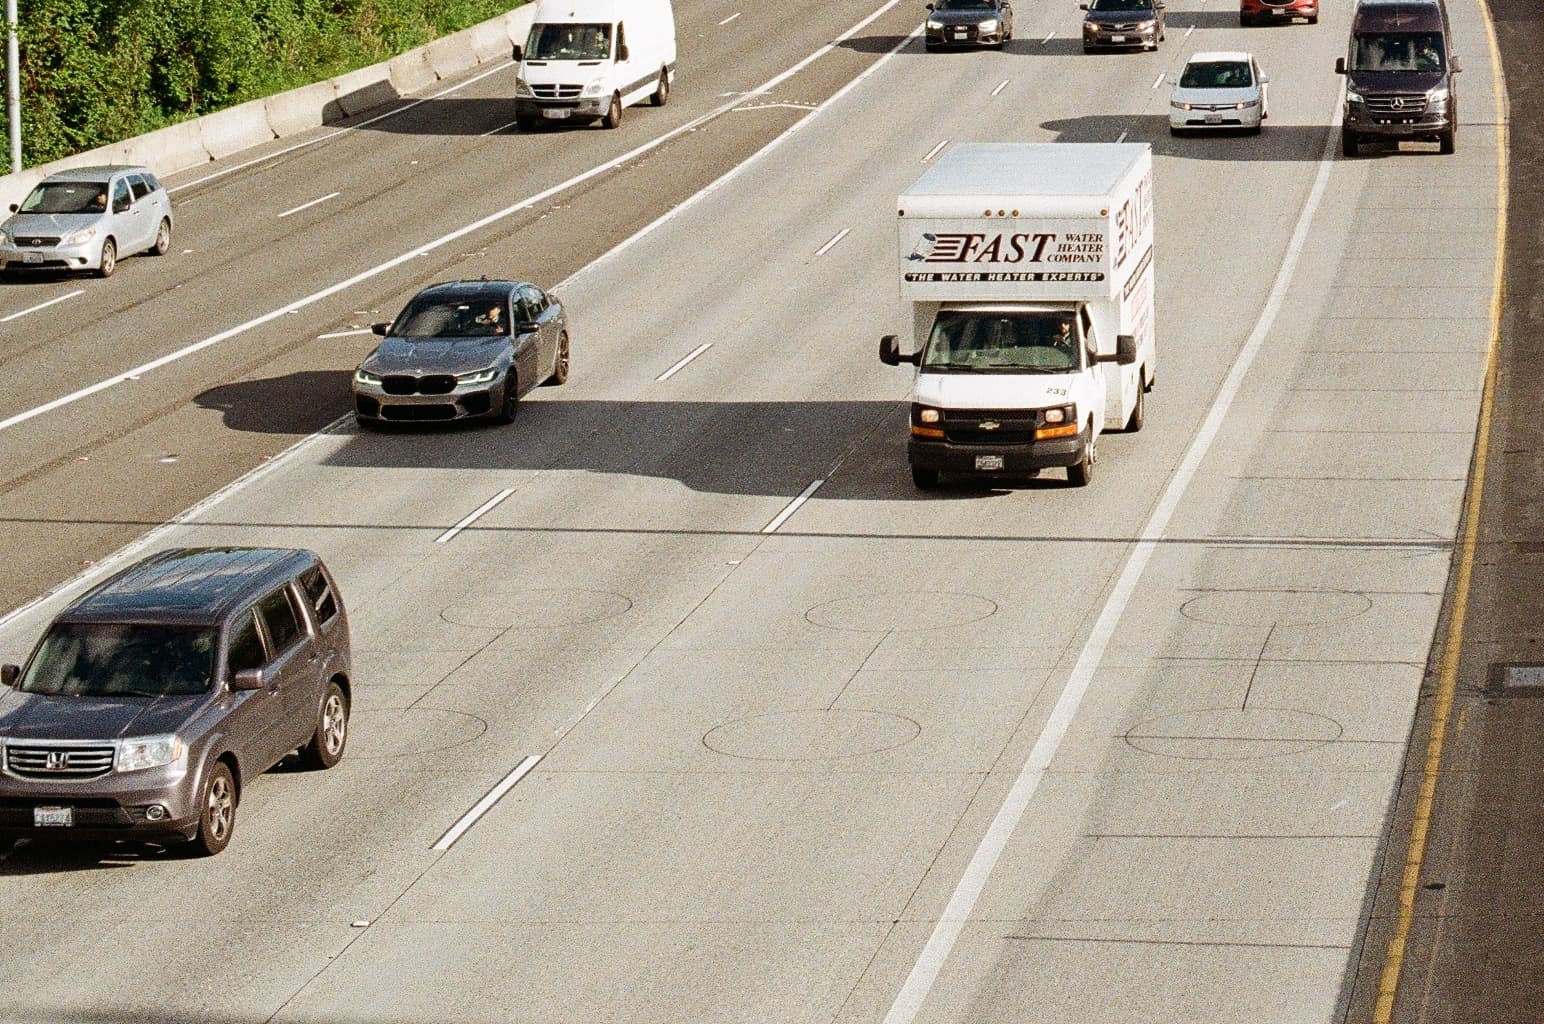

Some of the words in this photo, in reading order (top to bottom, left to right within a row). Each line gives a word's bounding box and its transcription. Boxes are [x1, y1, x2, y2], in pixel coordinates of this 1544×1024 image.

[1065, 233, 1103, 243] WATER
[957, 233, 1056, 263] FAST
[1057, 243, 1103, 253] HEATER
[1047, 254, 1102, 263] COMPANY
[941, 273, 980, 282] WATER
[988, 273, 1034, 282] HEATER
